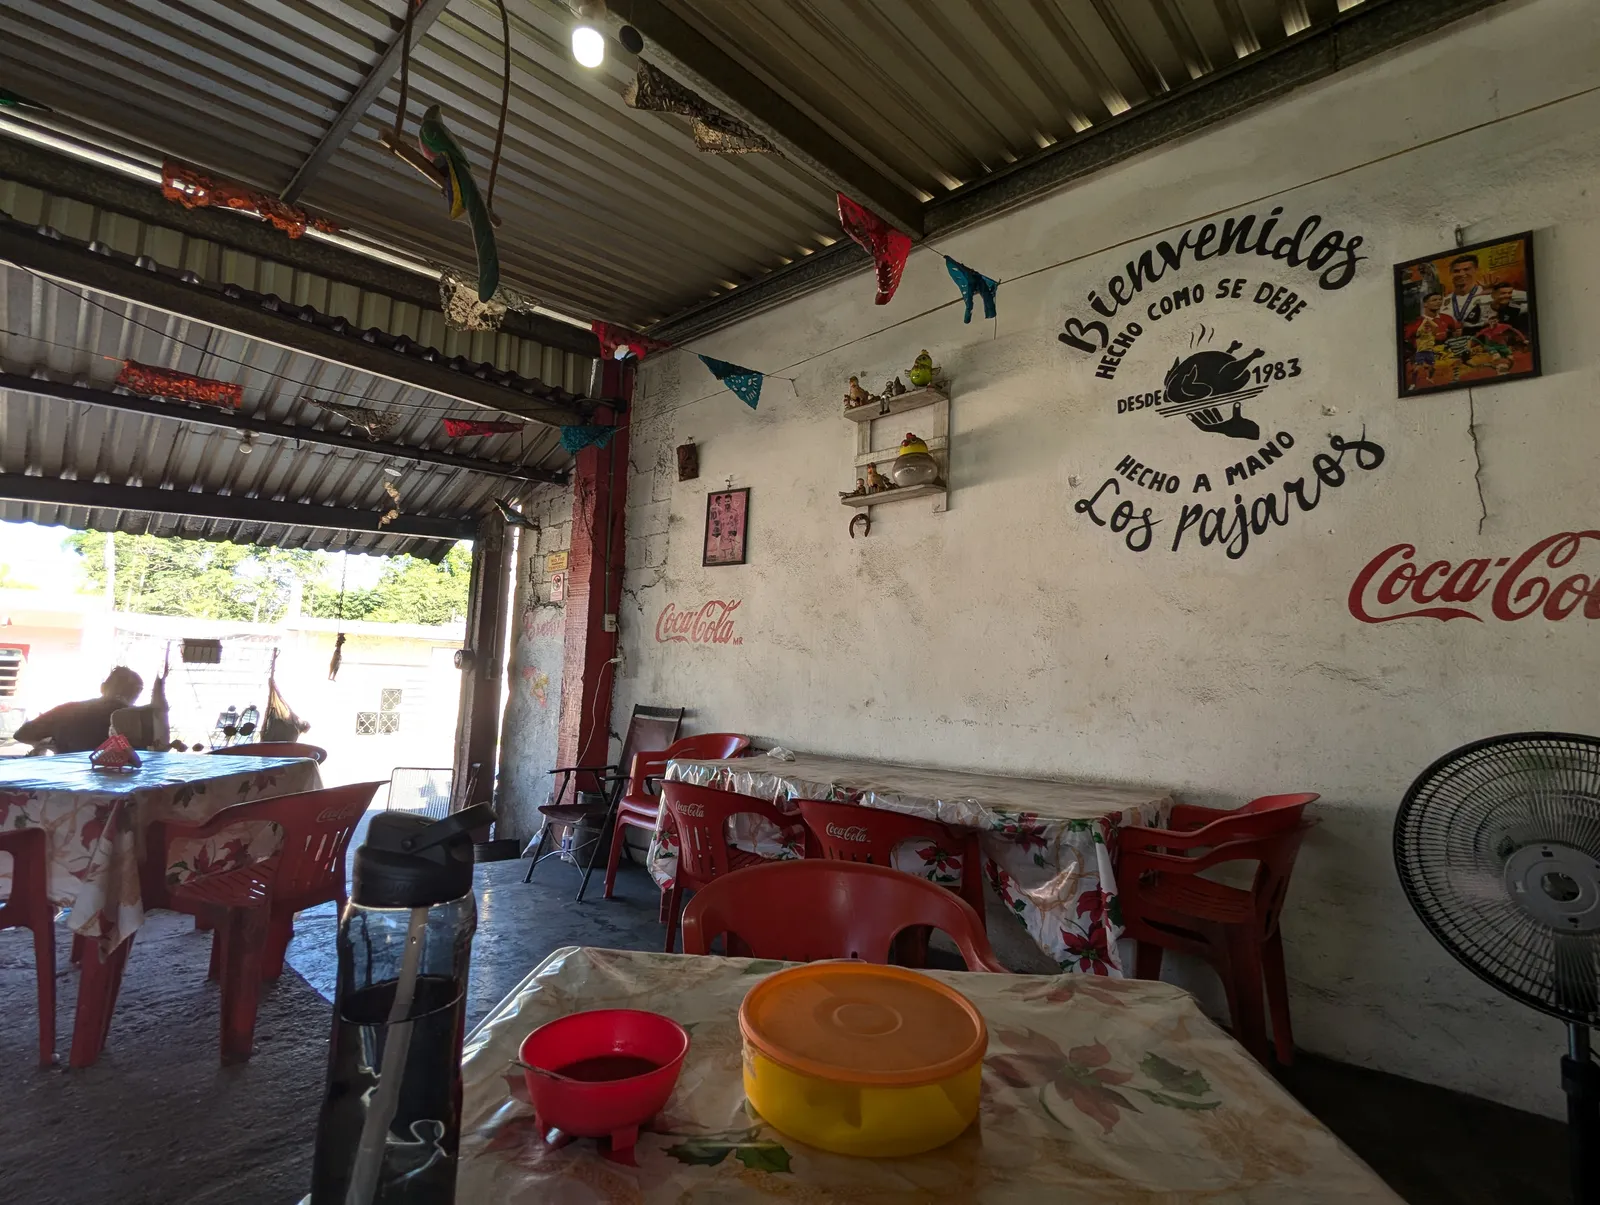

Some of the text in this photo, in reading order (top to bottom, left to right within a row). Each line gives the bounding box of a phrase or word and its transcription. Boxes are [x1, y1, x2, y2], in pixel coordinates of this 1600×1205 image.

[1058, 207, 1368, 354] Bienvenidos
[1095, 278, 1308, 380] HECHO COMO SE DEBE
[1117, 358, 1302, 414] DESDE 1983
[1114, 431, 1295, 494] HECHO A MANO
[1074, 477, 1163, 552] Los
[1348, 530, 1600, 624] Coca-Co
[655, 599, 742, 644] Coca-Cola
[825, 821, 868, 842] Coca-Cola
